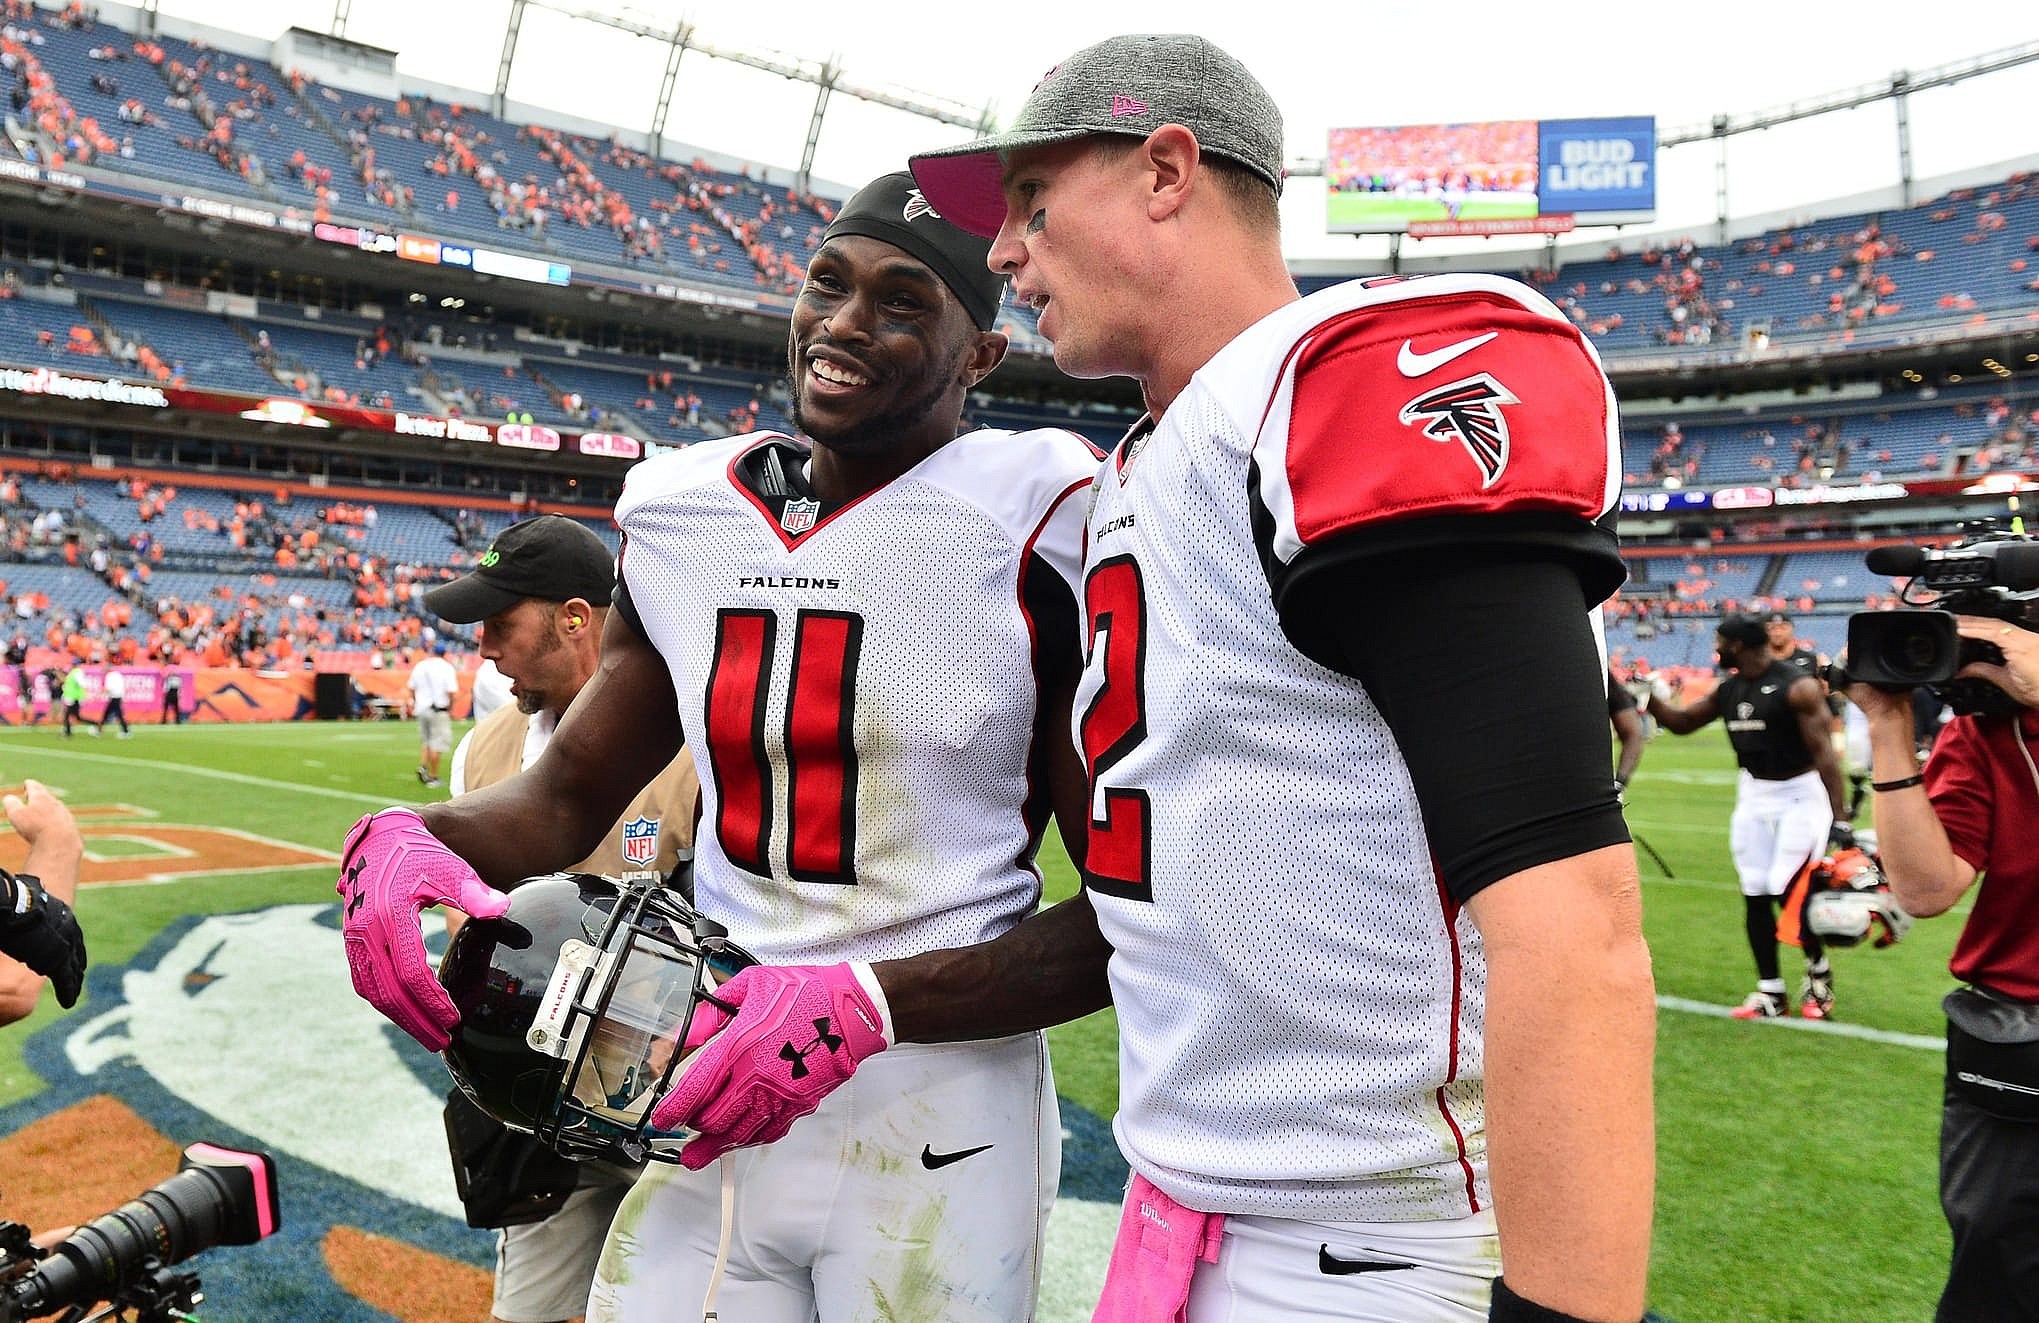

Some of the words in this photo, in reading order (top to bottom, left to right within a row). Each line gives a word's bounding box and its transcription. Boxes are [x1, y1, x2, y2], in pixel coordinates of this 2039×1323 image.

[1561, 139, 1635, 167] BUD
[1549, 162, 1649, 191] LIGHT
[786, 513, 811, 528] NFL
[739, 576, 841, 589] FALCONS
[1080, 553, 1155, 903] 2
[704, 608, 865, 886] 11
[627, 838, 655, 859] NFL
[550, 972, 571, 1021] FALCONS
